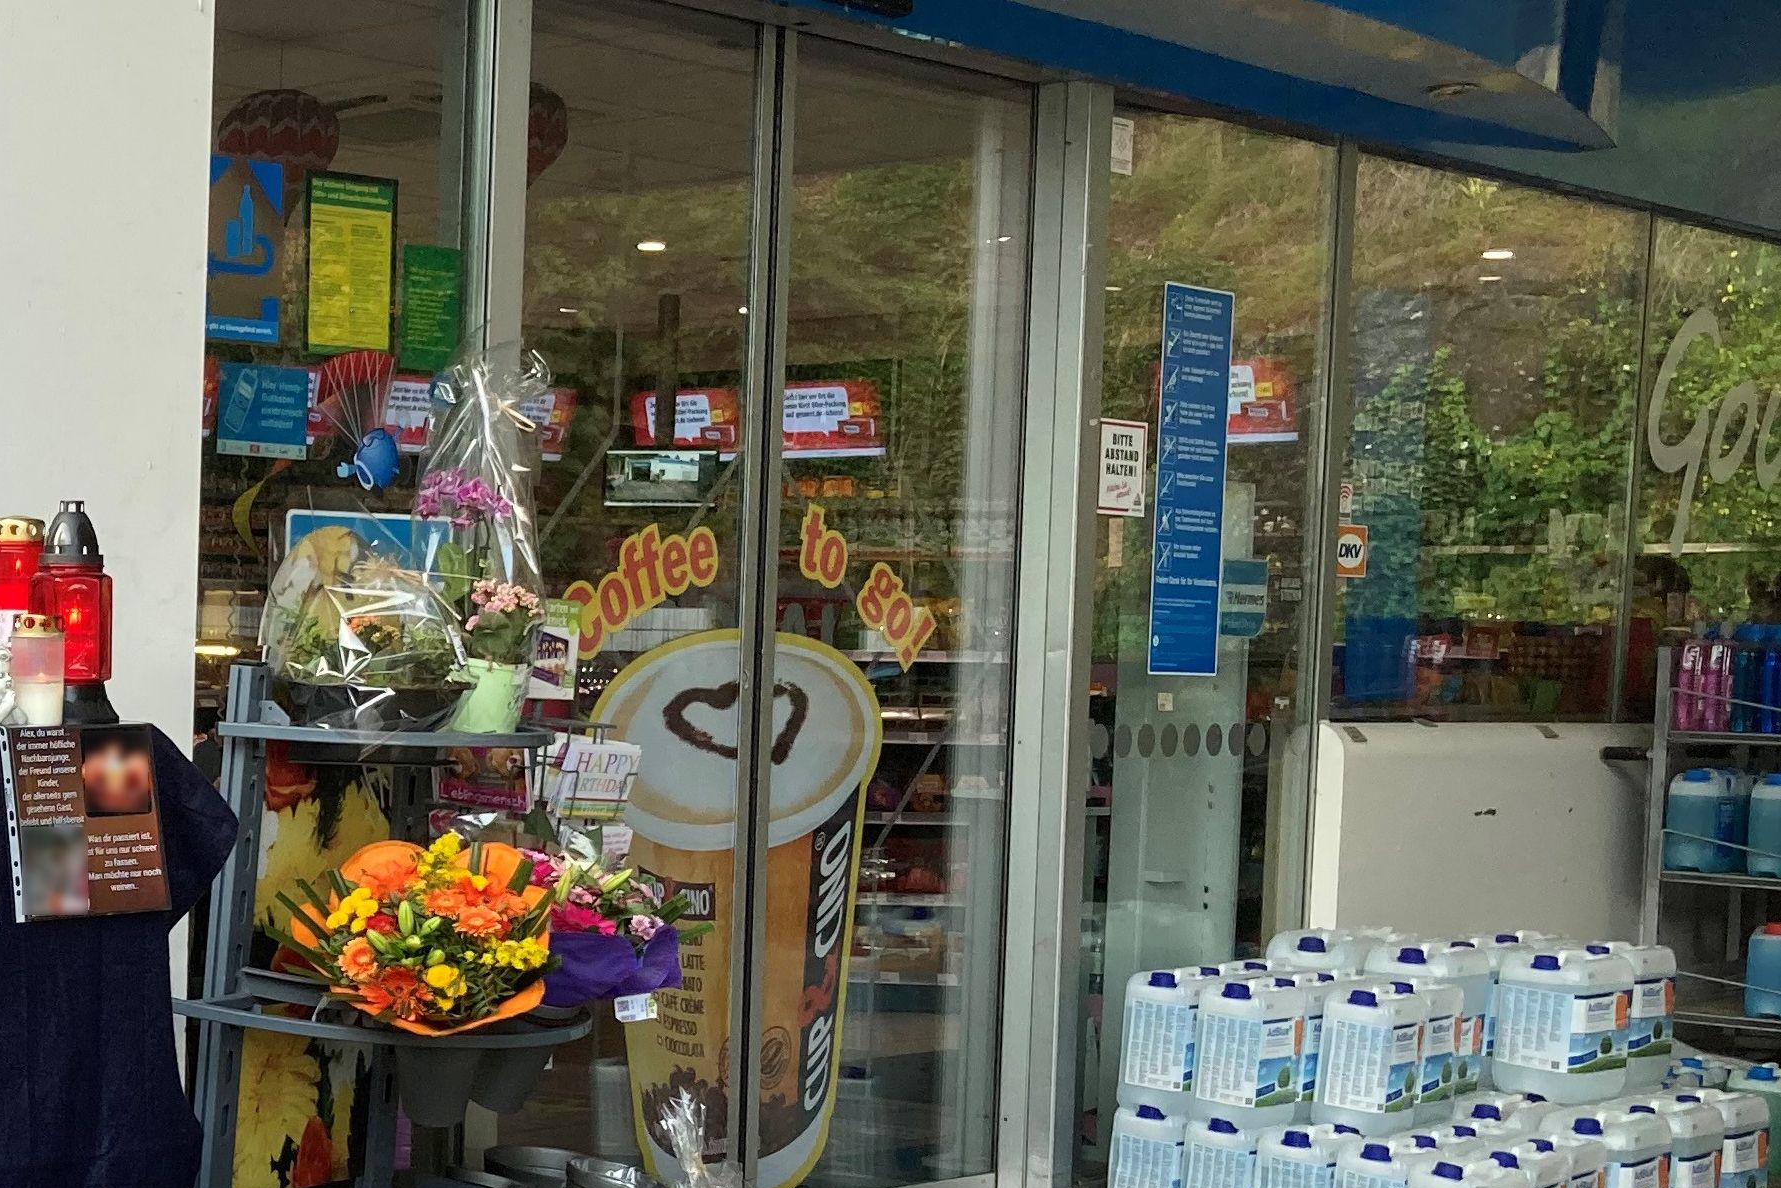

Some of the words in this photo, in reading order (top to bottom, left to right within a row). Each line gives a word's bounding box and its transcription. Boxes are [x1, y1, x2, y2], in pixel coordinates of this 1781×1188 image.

[1112, 433, 1133, 447] BITTE
[1105, 448, 1139, 462] ABSTAND
[1106, 463, 1137, 477] HALTEN!
[1338, 543, 1362, 558] DKV
[566, 525, 717, 657] Coffee
[802, 506, 846, 587] to
[860, 564, 935, 668] go!
[1234, 591, 1264, 606] Hermes
[20, 729, 36, 738] Alex,
[36, 729, 45, 737] du
[16, 743, 27, 751] der
[27, 742, 49, 750] immer
[577, 751, 640, 775] HAPPY
[18, 768, 29, 776] der
[29, 766, 52, 775] Freund
[22, 793, 32, 801] der
[88, 834, 102, 843] Was
[113, 832, 140, 843] passiert
[87, 848, 95, 856] st
[95, 847, 105, 856] für
[105, 847, 118, 855] uns
[131, 844, 158, 853] schwer
[88, 873, 103, 881] Man
[104, 870, 130, 880] möchte
[143, 868, 162, 876] noch
[814, 820, 851, 958] CINO
[682, 954, 706, 971] LATTE
[663, 1017, 698, 1037] ESPRESSO
[804, 1014, 833, 1111] CUP
